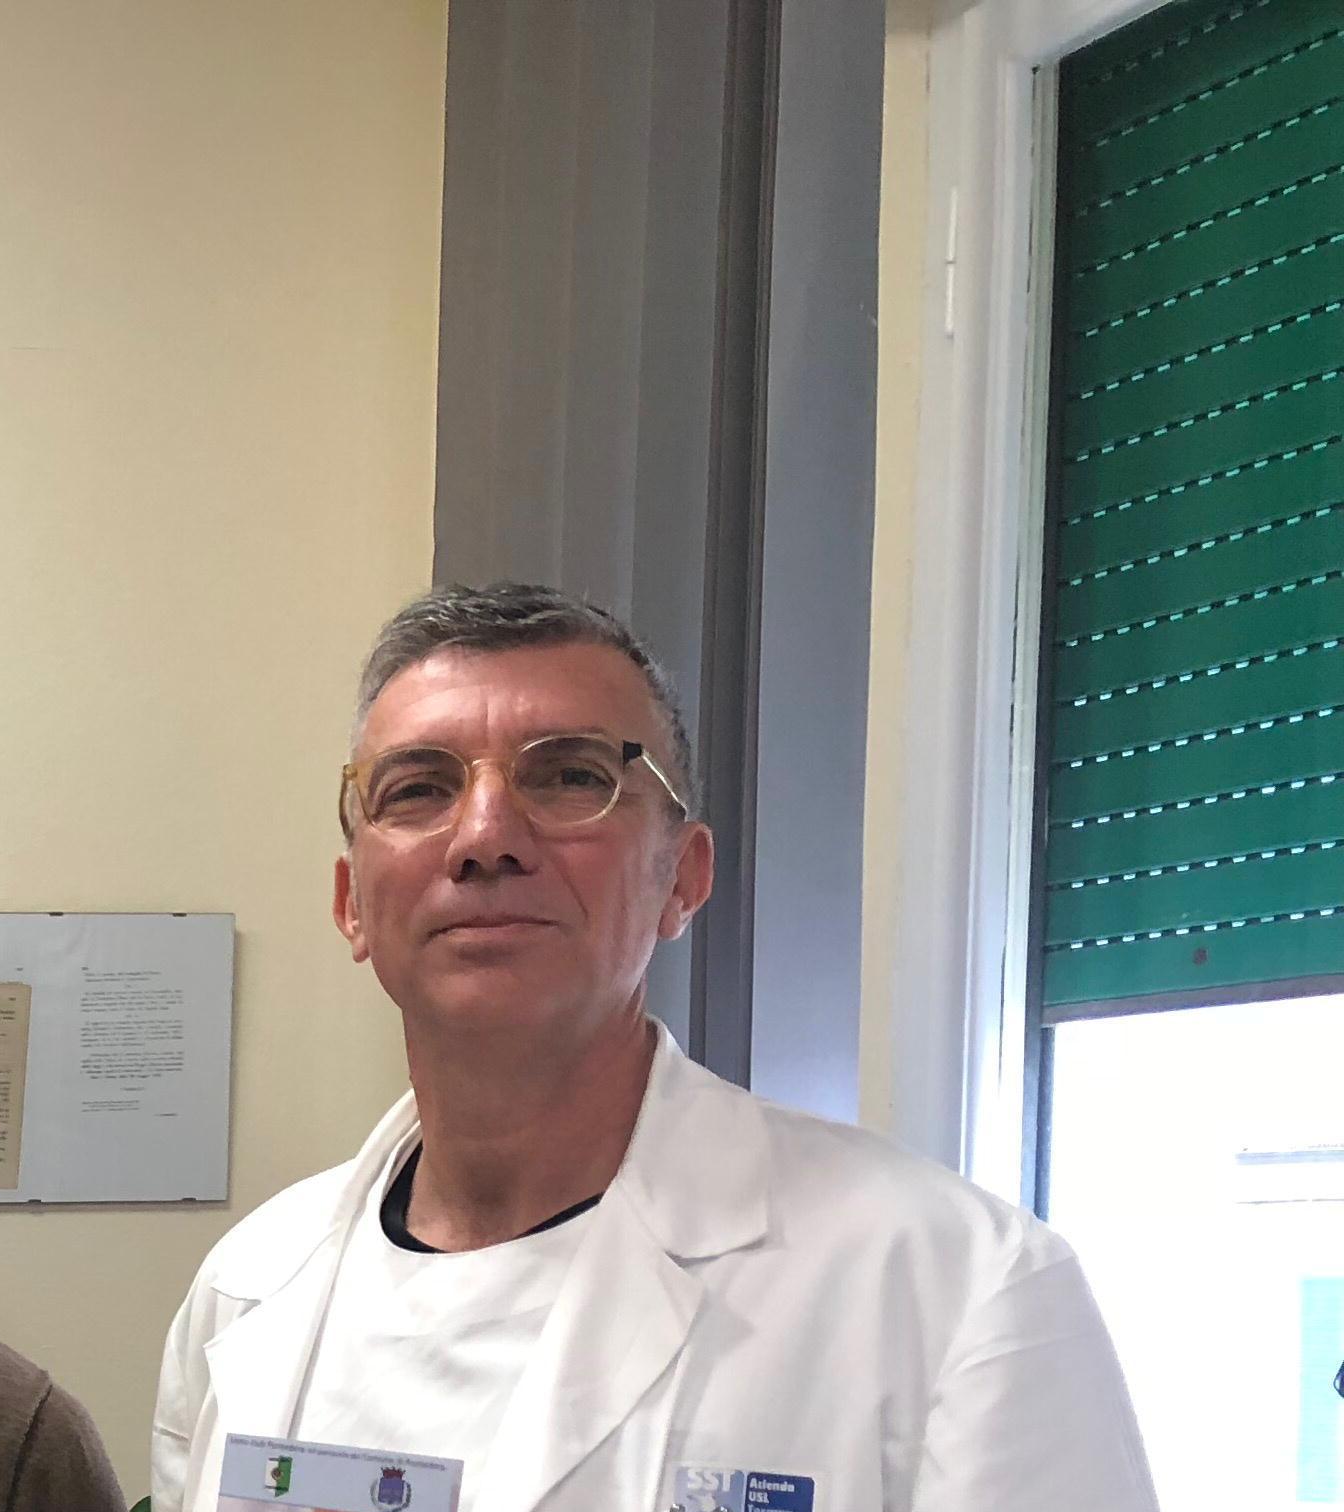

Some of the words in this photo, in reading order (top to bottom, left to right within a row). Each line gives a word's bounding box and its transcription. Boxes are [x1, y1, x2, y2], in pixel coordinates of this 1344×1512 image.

[687, 1468, 732, 1492] SST
[750, 1478, 795, 1492] Azienda
[749, 1491, 769, 1504] USL
